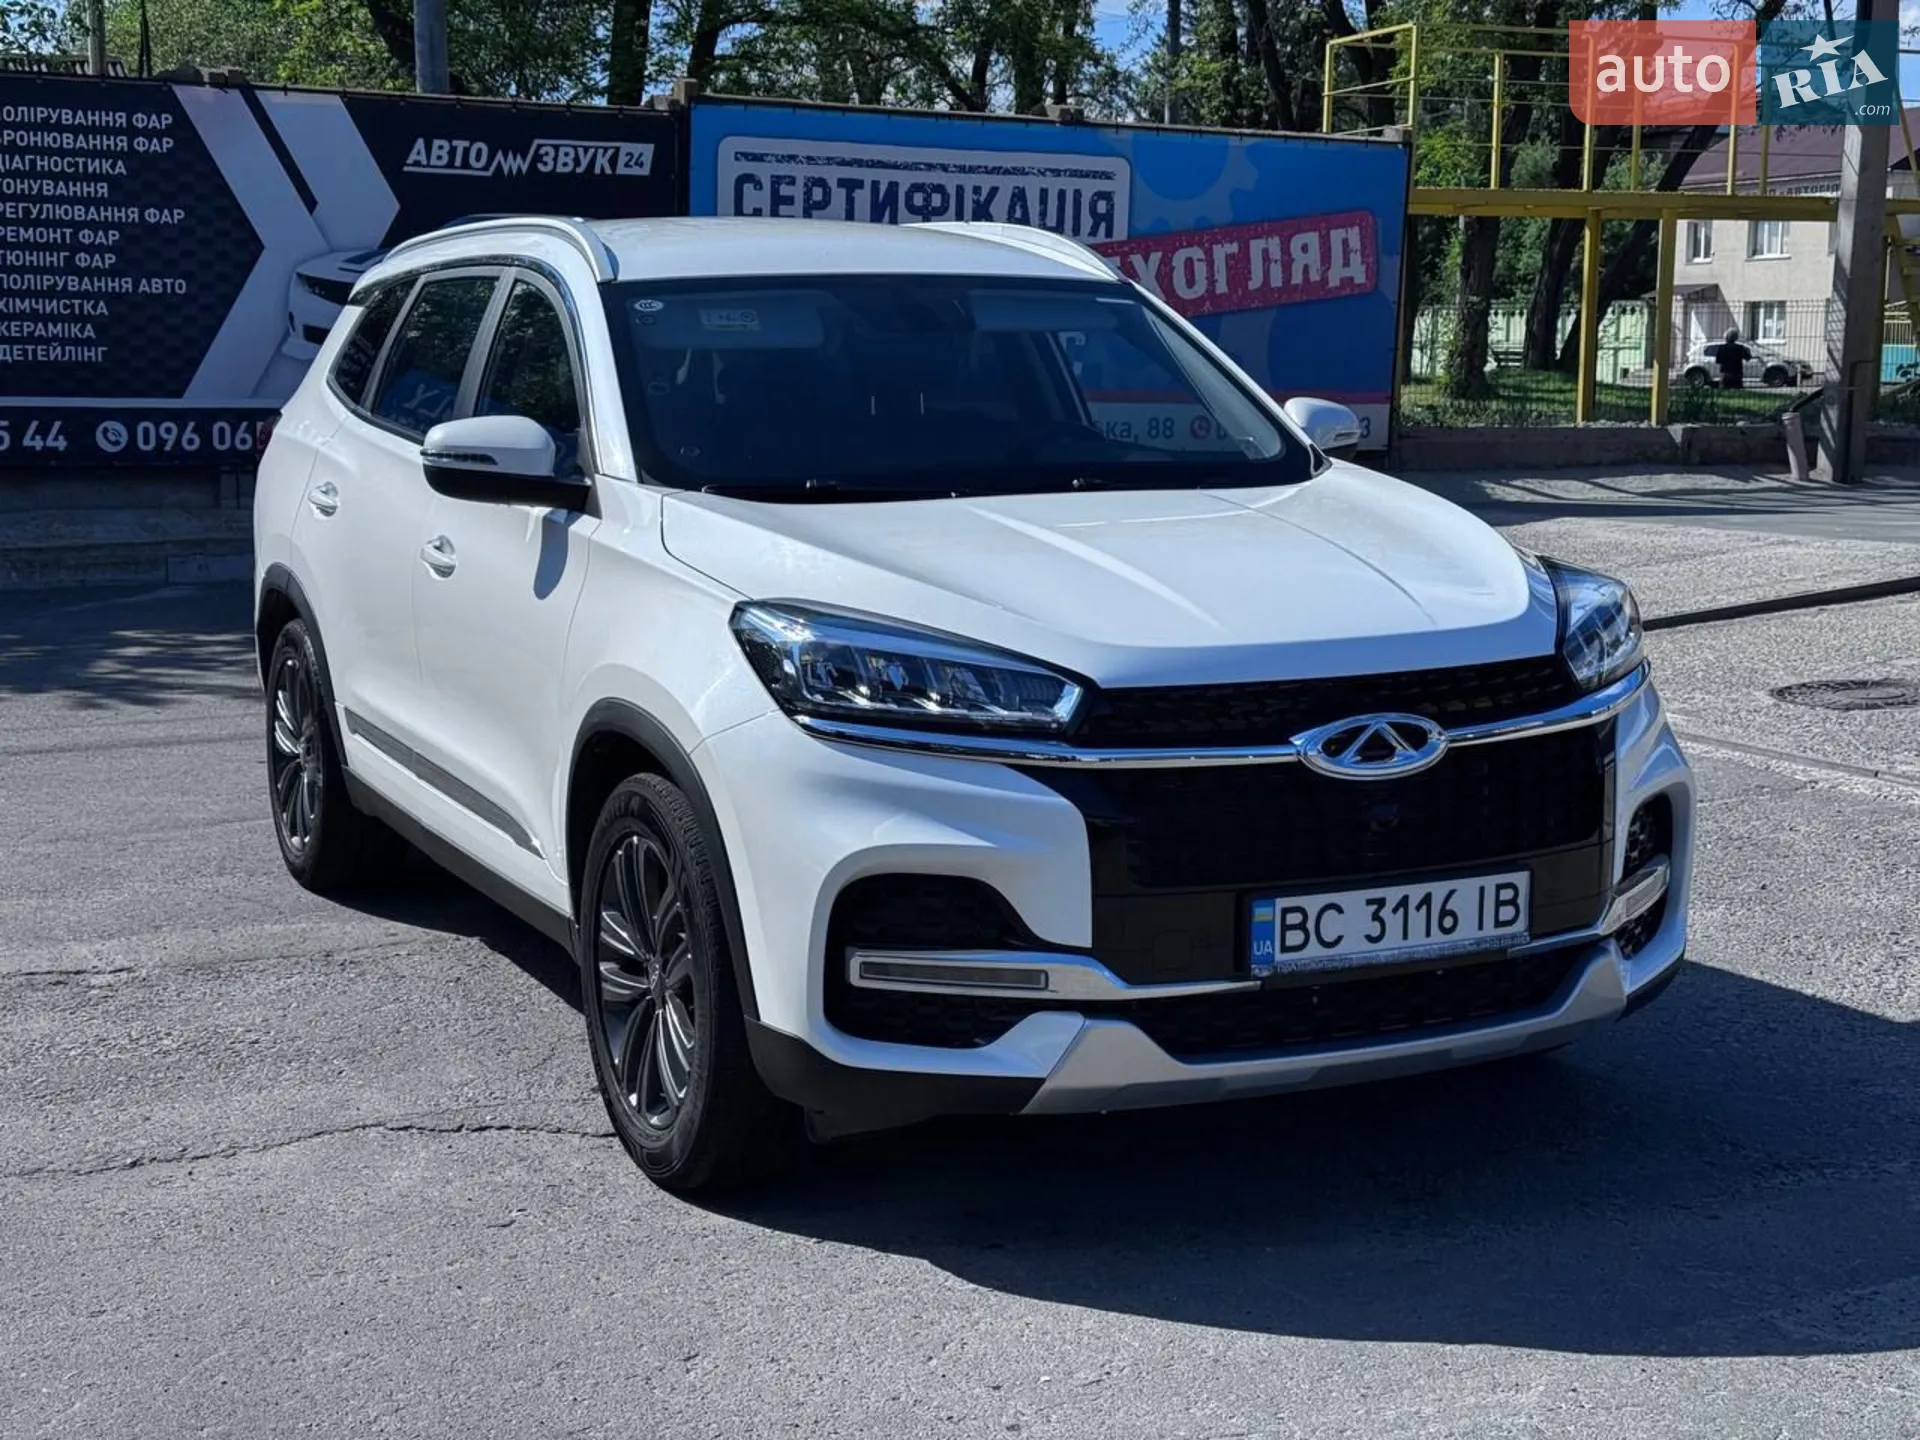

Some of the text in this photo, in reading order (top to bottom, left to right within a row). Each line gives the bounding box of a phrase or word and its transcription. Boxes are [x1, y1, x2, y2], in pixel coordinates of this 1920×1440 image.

[0, 106, 173, 130] ОЛІРУВАННЯ ФАР
[0, 130, 174, 153] РОНЮВАННЯ ФАР
[405, 138, 646, 175] АВТО ЗВУК 24
[0, 178, 109, 198] ОНУВАННЯ
[144, 207, 186, 225] ФАР
[78, 228, 120, 246] ФАР
[75, 252, 117, 269] ФАР
[1104, 226, 1367, 301] ХОГЛЯД
[138, 277, 187, 295] АВТО
[0, 341, 108, 363] ДЕТЕЙЛІНГ
[22, 420, 68, 451] 44
[137, 420, 200, 451] 096
[1279, 902, 1345, 954] BC
[1364, 888, 1459, 944] 3116
[1477, 881, 1521, 931] IB
[1253, 939, 1274, 955] UA
